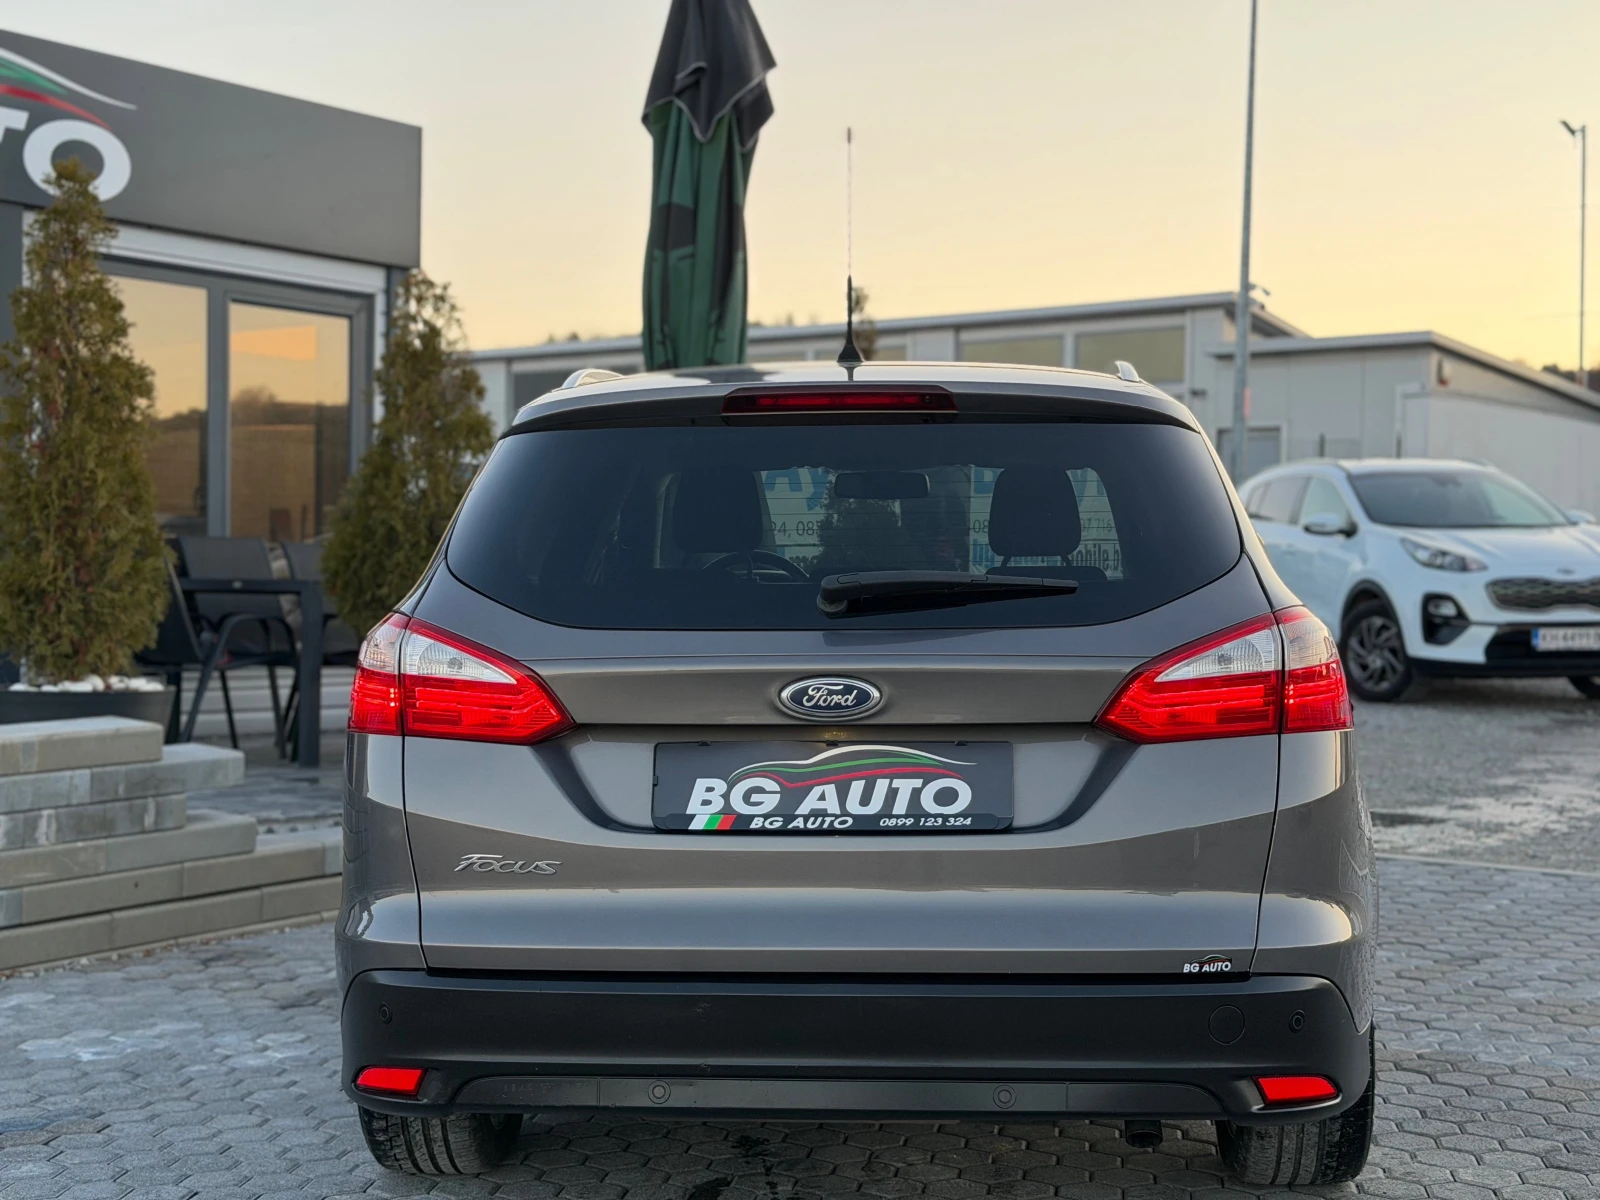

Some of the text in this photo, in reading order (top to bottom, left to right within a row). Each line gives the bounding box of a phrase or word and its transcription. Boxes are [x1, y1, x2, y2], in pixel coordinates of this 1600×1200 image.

[802, 684, 858, 707] Ford
[685, 777, 973, 815] BG AUTO
[749, 815, 973, 829] BG AUTO 0899 123 324
[1182, 961, 1232, 973] BG AUTO
